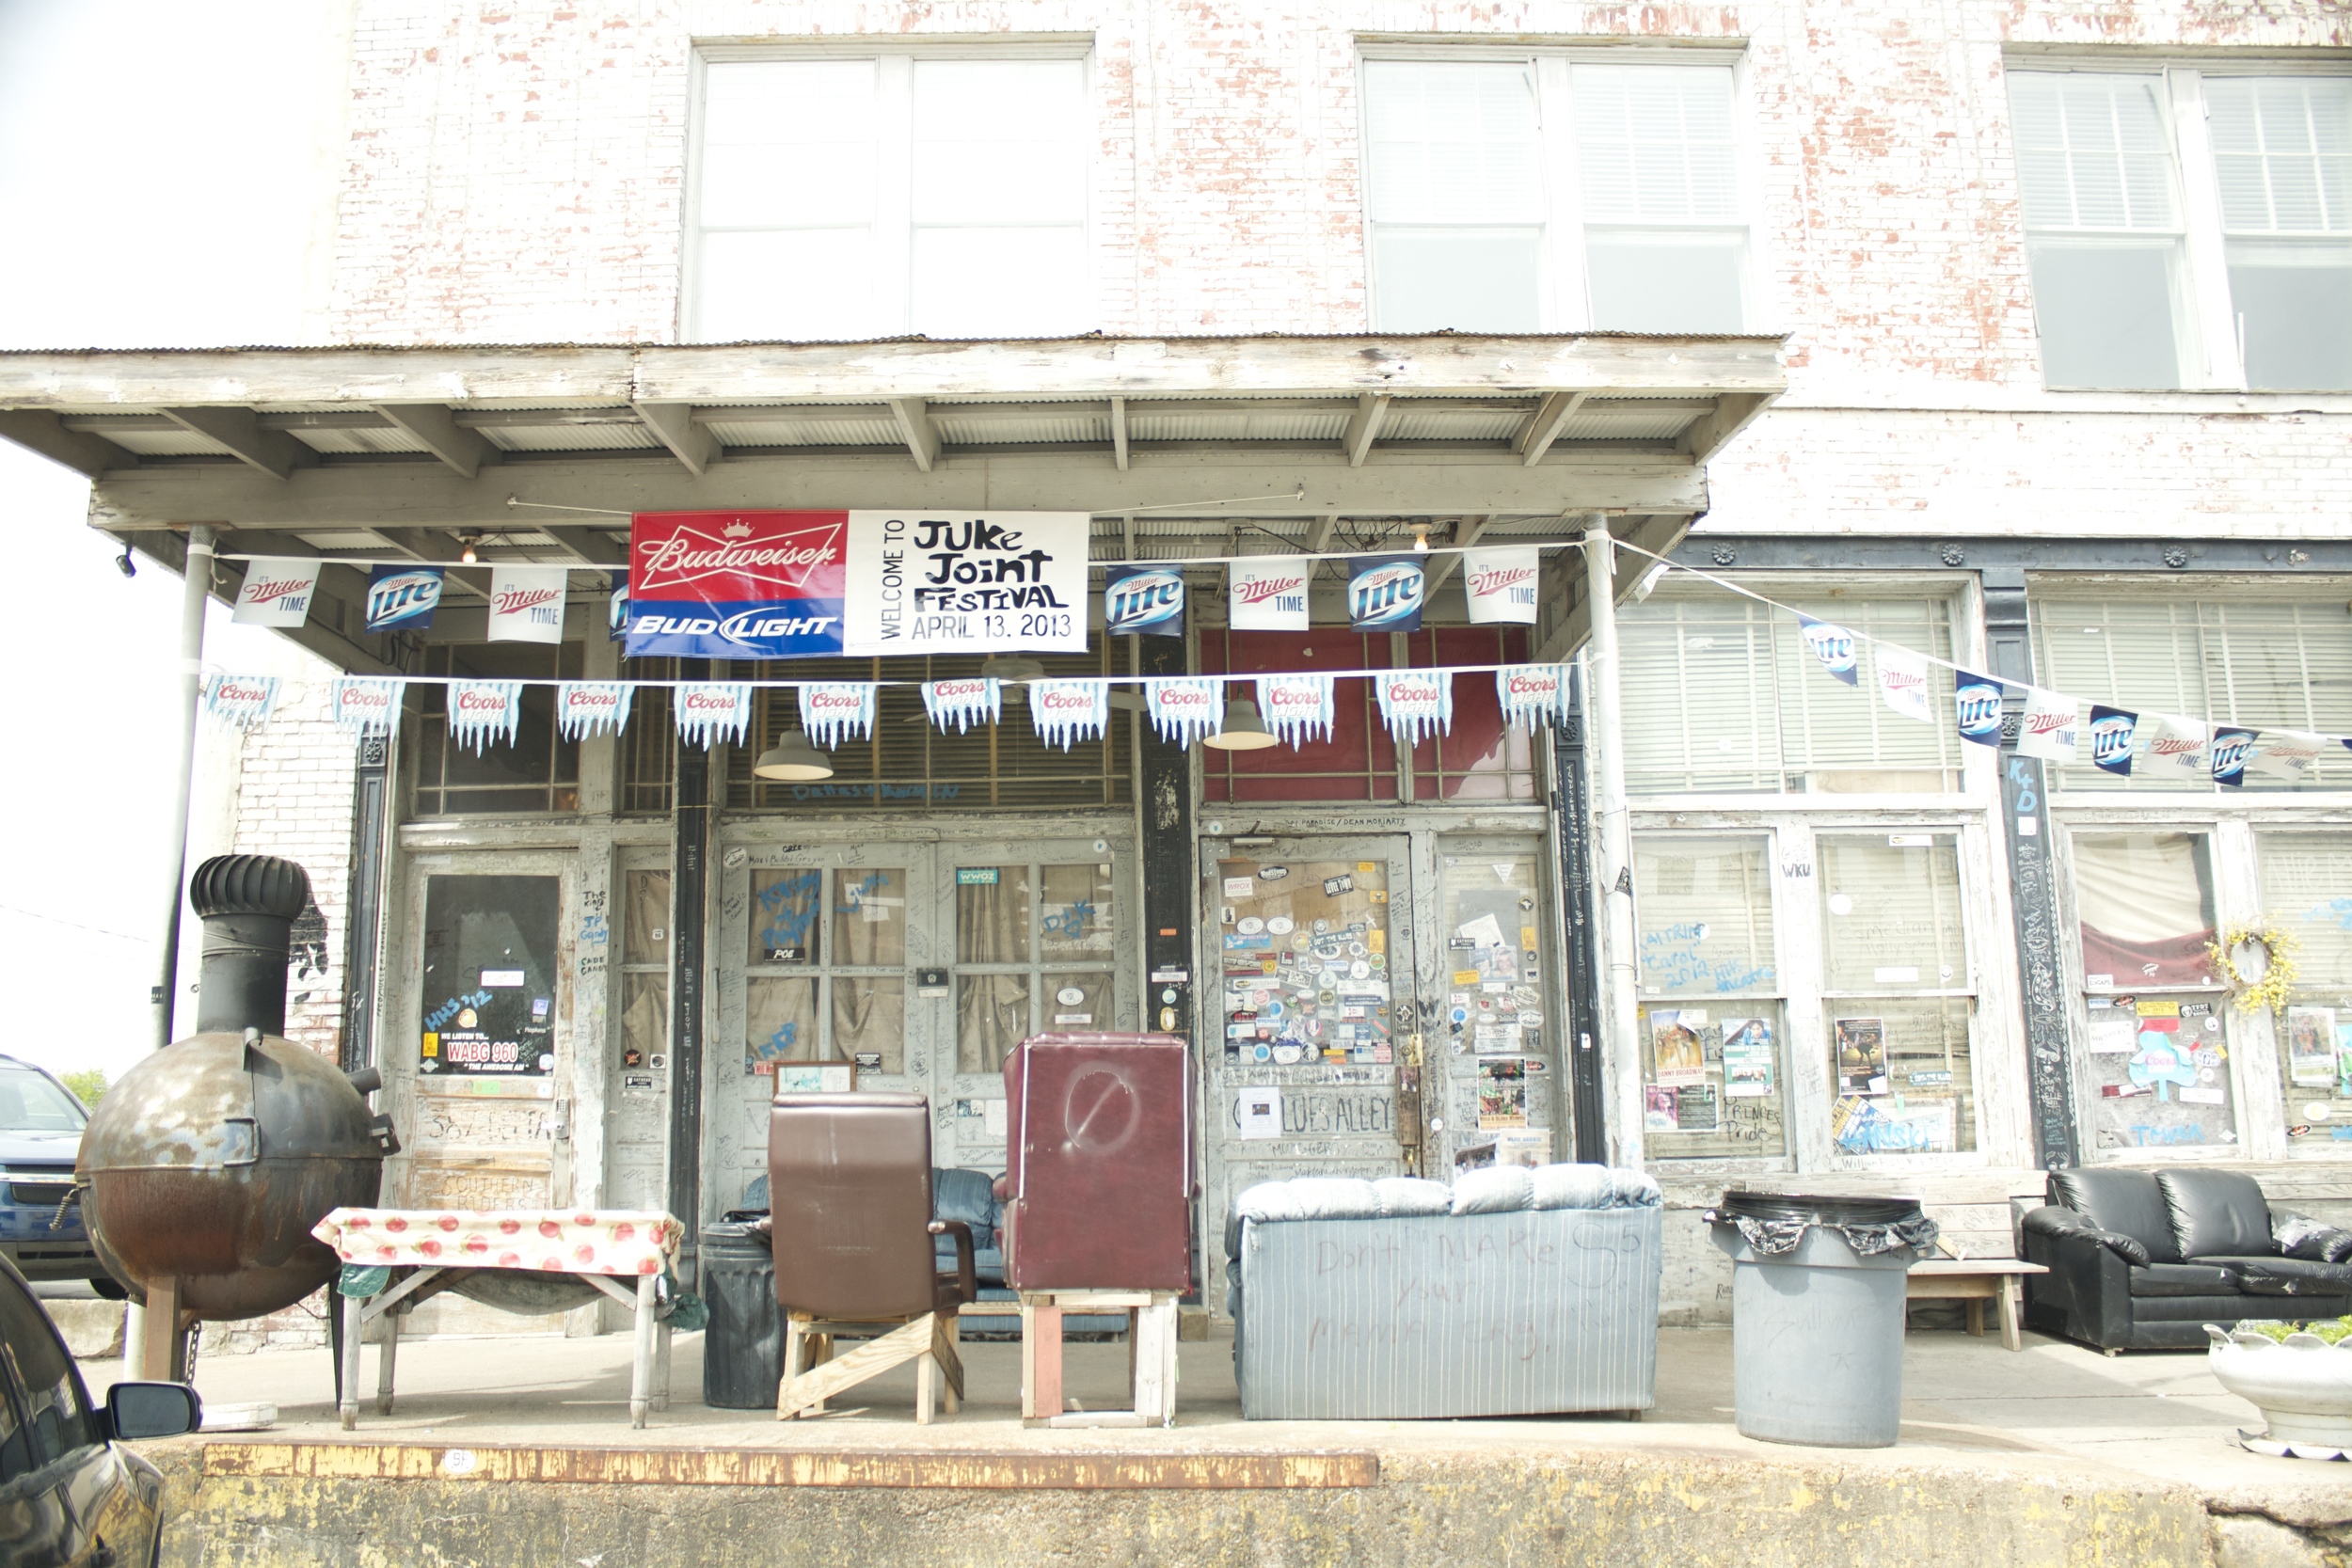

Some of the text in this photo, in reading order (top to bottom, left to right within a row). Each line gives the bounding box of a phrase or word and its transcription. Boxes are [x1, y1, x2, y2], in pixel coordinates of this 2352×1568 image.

[638, 538, 837, 572] Budweiser
[925, 550, 1053, 585] Joint
[881, 519, 905, 640] WELCOME TO
[1468, 567, 1536, 597] Miller
[244, 578, 314, 603] Miller
[914, 585, 1070, 612] FESTIVAL
[1232, 577, 1304, 604] Miller
[1509, 587, 1534, 605] TIME
[278, 596, 308, 611] TIME
[368, 580, 438, 627] Lite
[492, 589, 564, 615] Miller
[1109, 581, 1180, 630] Lite
[1276, 596, 1304, 611] TIME
[1353, 574, 1421, 626] Lite
[531, 608, 559, 625] TIME
[632, 615, 717, 635] BUD
[731, 616, 838, 638] LIGHT
[912, 615, 975, 640] APRIL
[1021, 614, 1072, 638] 2013
[1509, 676, 1558, 694] Coors
[1881, 669, 1924, 689] Miller
[218, 684, 266, 702] Coors
[342, 688, 389, 707] Coors
[569, 690, 617, 705] Coors
[935, 680, 986, 698] Coors
[1159, 689, 1211, 705] Coors
[1271, 688, 1321, 705] Coors
[1390, 683, 1439, 702] Coors
[1511, 691, 1555, 705] LIGHT
[1907, 689, 1927, 707] TIME
[459, 691, 506, 710] Coors
[686, 693, 736, 709] Coors
[810, 692, 860, 708] Coors
[939, 692, 985, 707] LIGHT
[1043, 692, 1093, 709] Coors
[1391, 701, 1437, 714] LIGHT
[459, 709, 504, 721] LIGHT
[568, 705, 615, 716] LIGHT
[685, 707, 734, 720] LIGHT
[811, 706, 858, 719] LIGHT
[1161, 705, 1208, 716] LIGHT
[1272, 705, 1317, 717] LIGHT
[1959, 697, 2000, 730] Lite
[2025, 709, 2076, 735] Miller
[2056, 729, 2075, 746] TIME
[2093, 727, 2132, 761] Lite
[2151, 738, 2204, 755] Miller
[2176, 753, 2200, 768] TIME
[2213, 741, 2250, 774] Lite
[2284, 756, 2306, 769] TIME
[2016, 790, 2037, 812] D
[1366, 817, 1406, 826] MORIARTY
[961, 872, 994, 880] WWOZ
[1781, 863, 1811, 878] WKU
[773, 949, 795, 958] POE
[447, 1041, 489, 1062] WABG
[491, 1041, 518, 1062] 960
[2145, 1053, 2177, 1066] Coors
[1657, 1068, 1704, 1078] DANNY BROADWAY
[1280, 1096, 1391, 1132] LUES ALLEY
